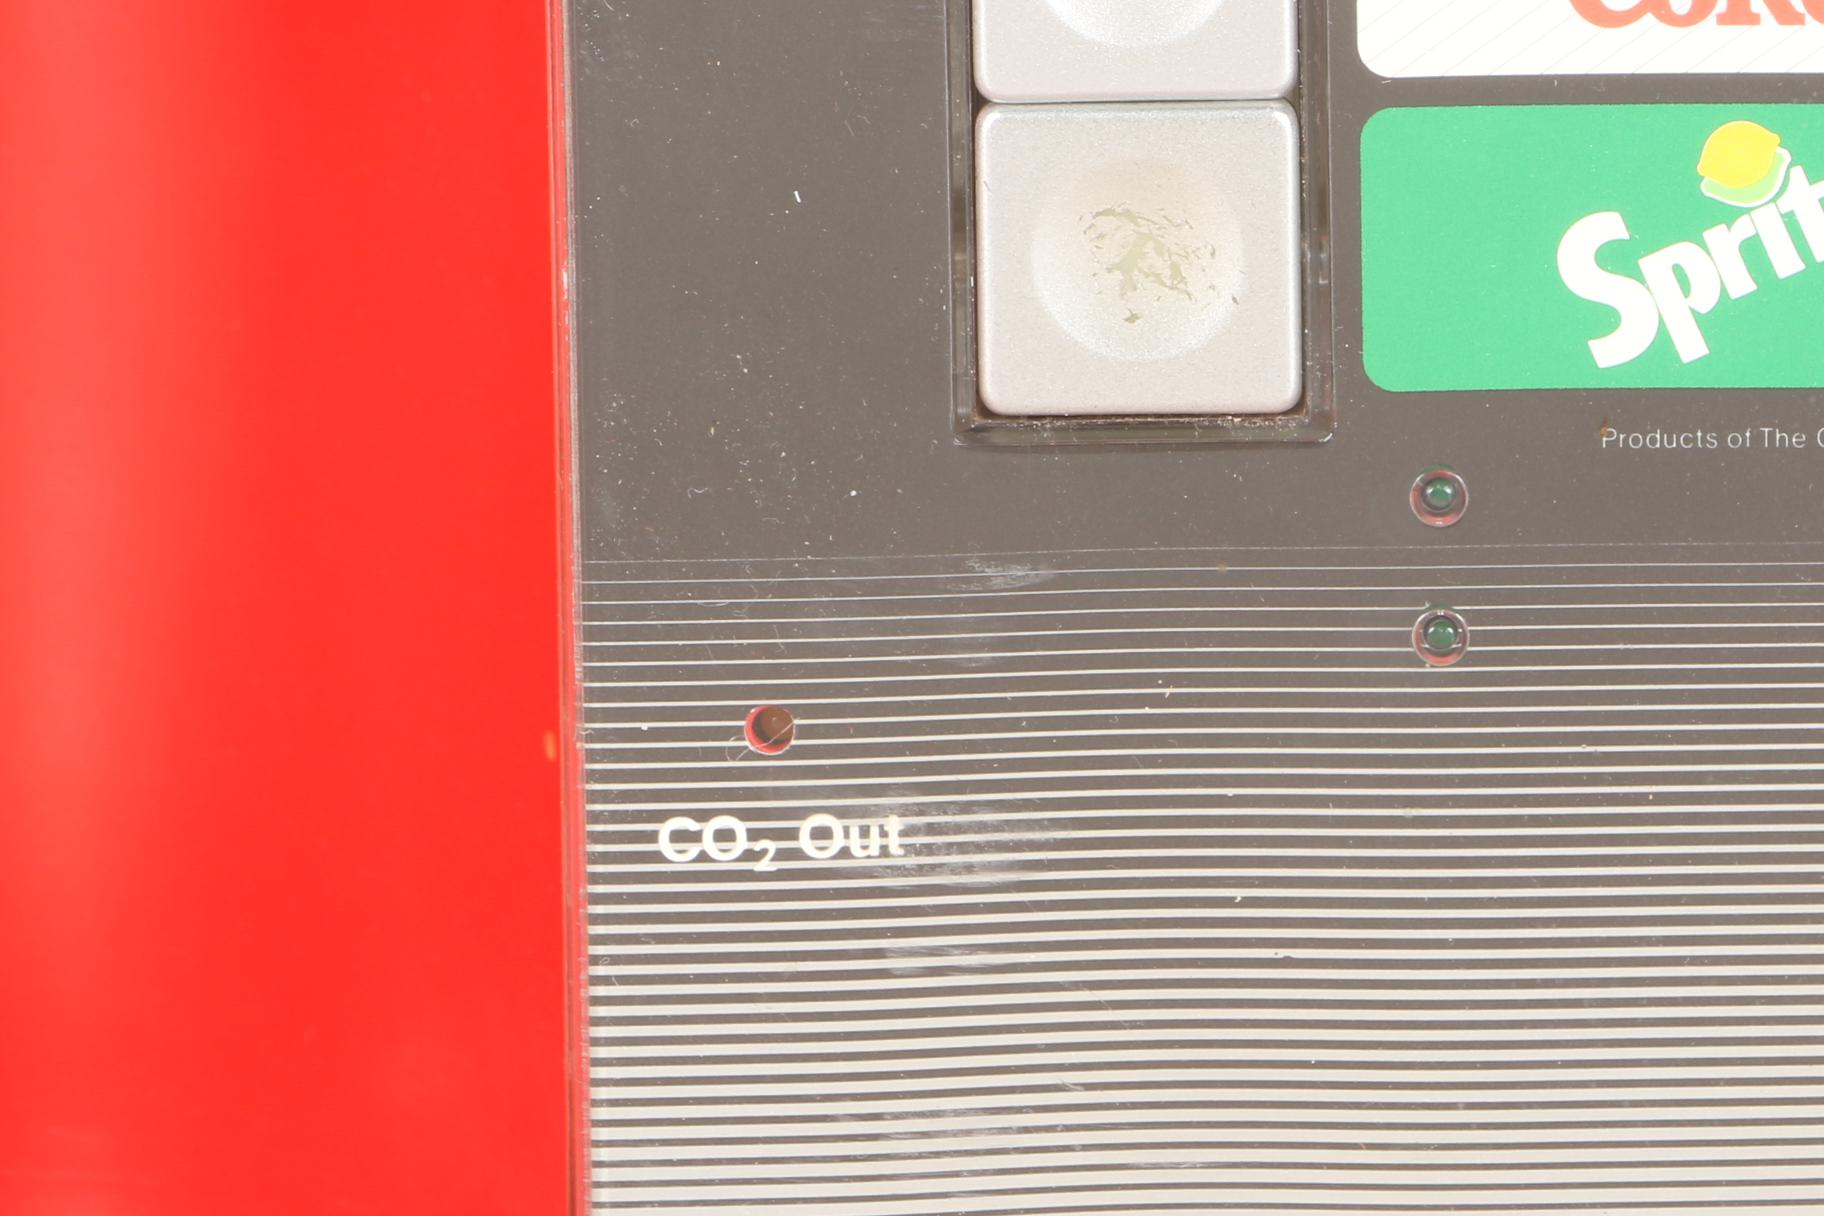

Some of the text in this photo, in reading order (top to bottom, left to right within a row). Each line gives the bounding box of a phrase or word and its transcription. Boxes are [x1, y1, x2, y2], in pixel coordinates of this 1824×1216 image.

[1601, 427, 1719, 449] Products
[1726, 427, 1752, 449] of
[1758, 427, 1806, 449] The
[798, 812, 904, 860] Out
